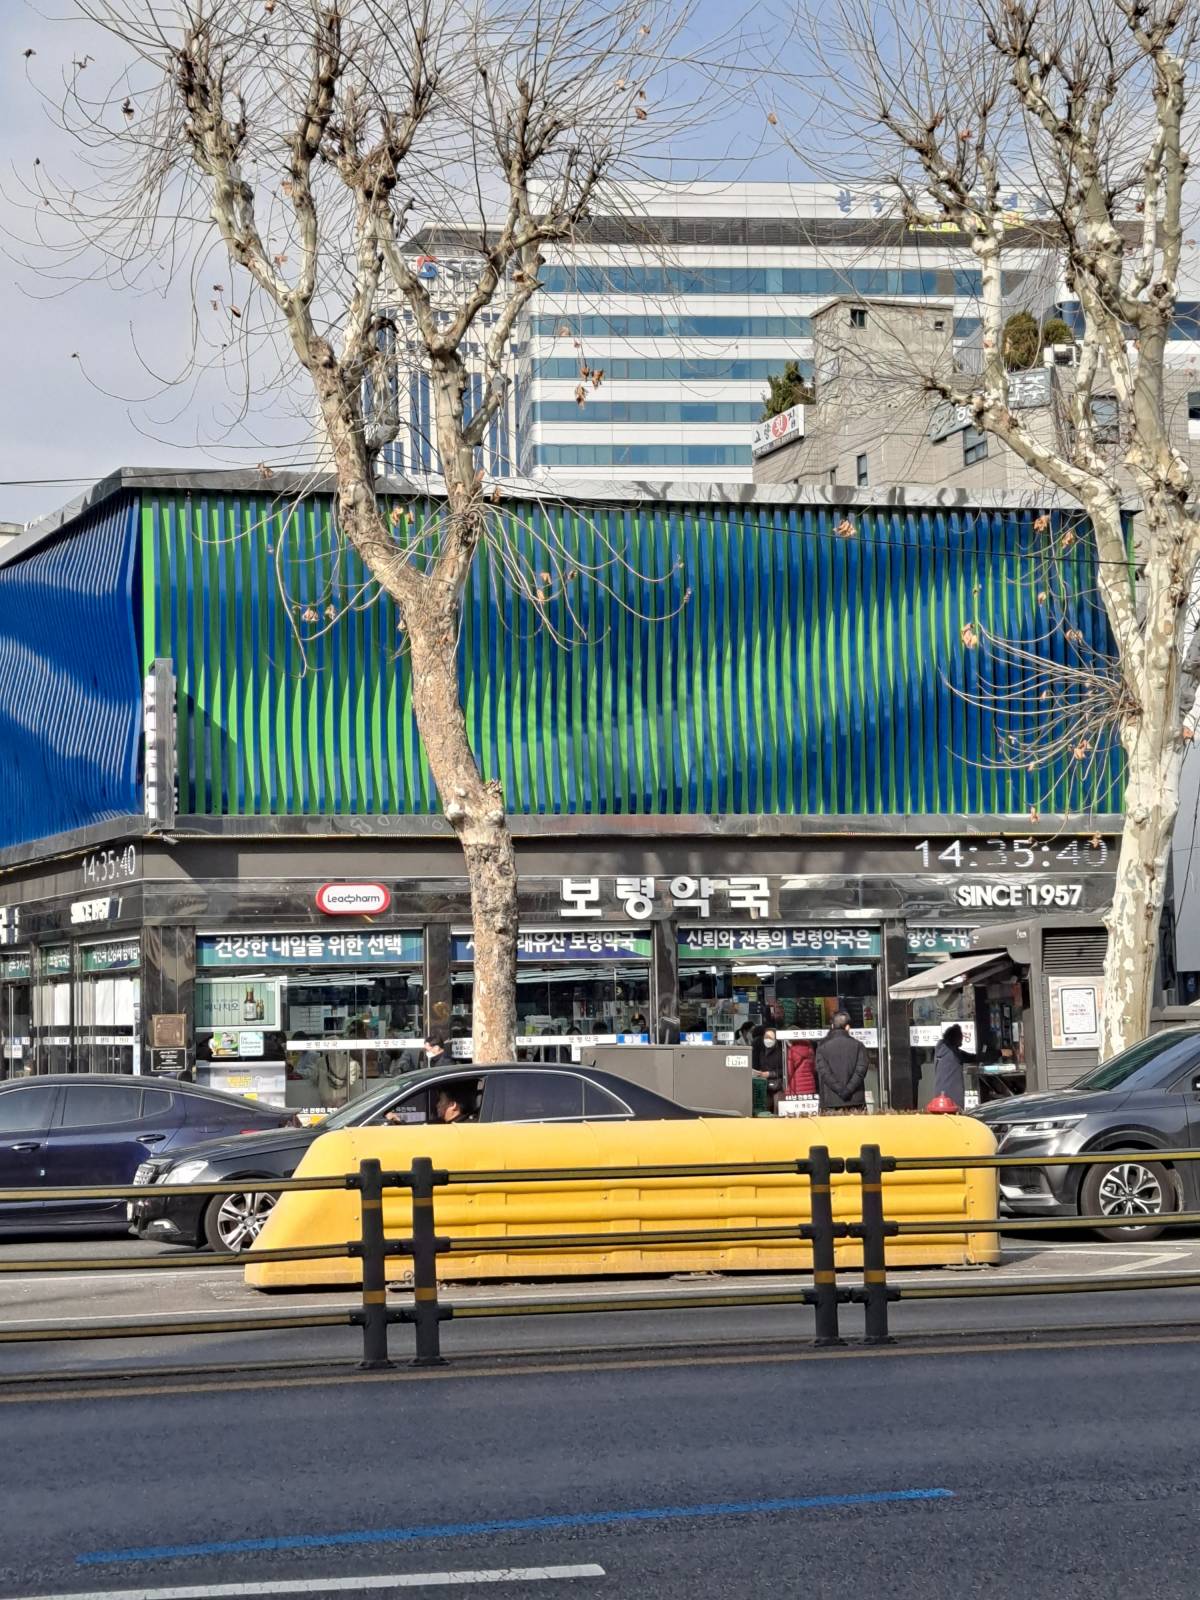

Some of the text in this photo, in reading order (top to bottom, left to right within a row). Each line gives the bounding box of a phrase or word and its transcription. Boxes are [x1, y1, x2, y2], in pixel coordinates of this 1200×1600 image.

[82, 845, 136, 884] 14:35:40
[914, 839, 1109, 868] 14:35:40
[560, 876, 770, 919] 보령약국
[958, 885, 1082, 906] SINCE 1957
[215, 934, 402, 958] 건강한 내일을 위한 선택
[569, 932, 636, 953] 보령약국
[686, 928, 872, 950] 신뢰와 전통의 보령약국은
